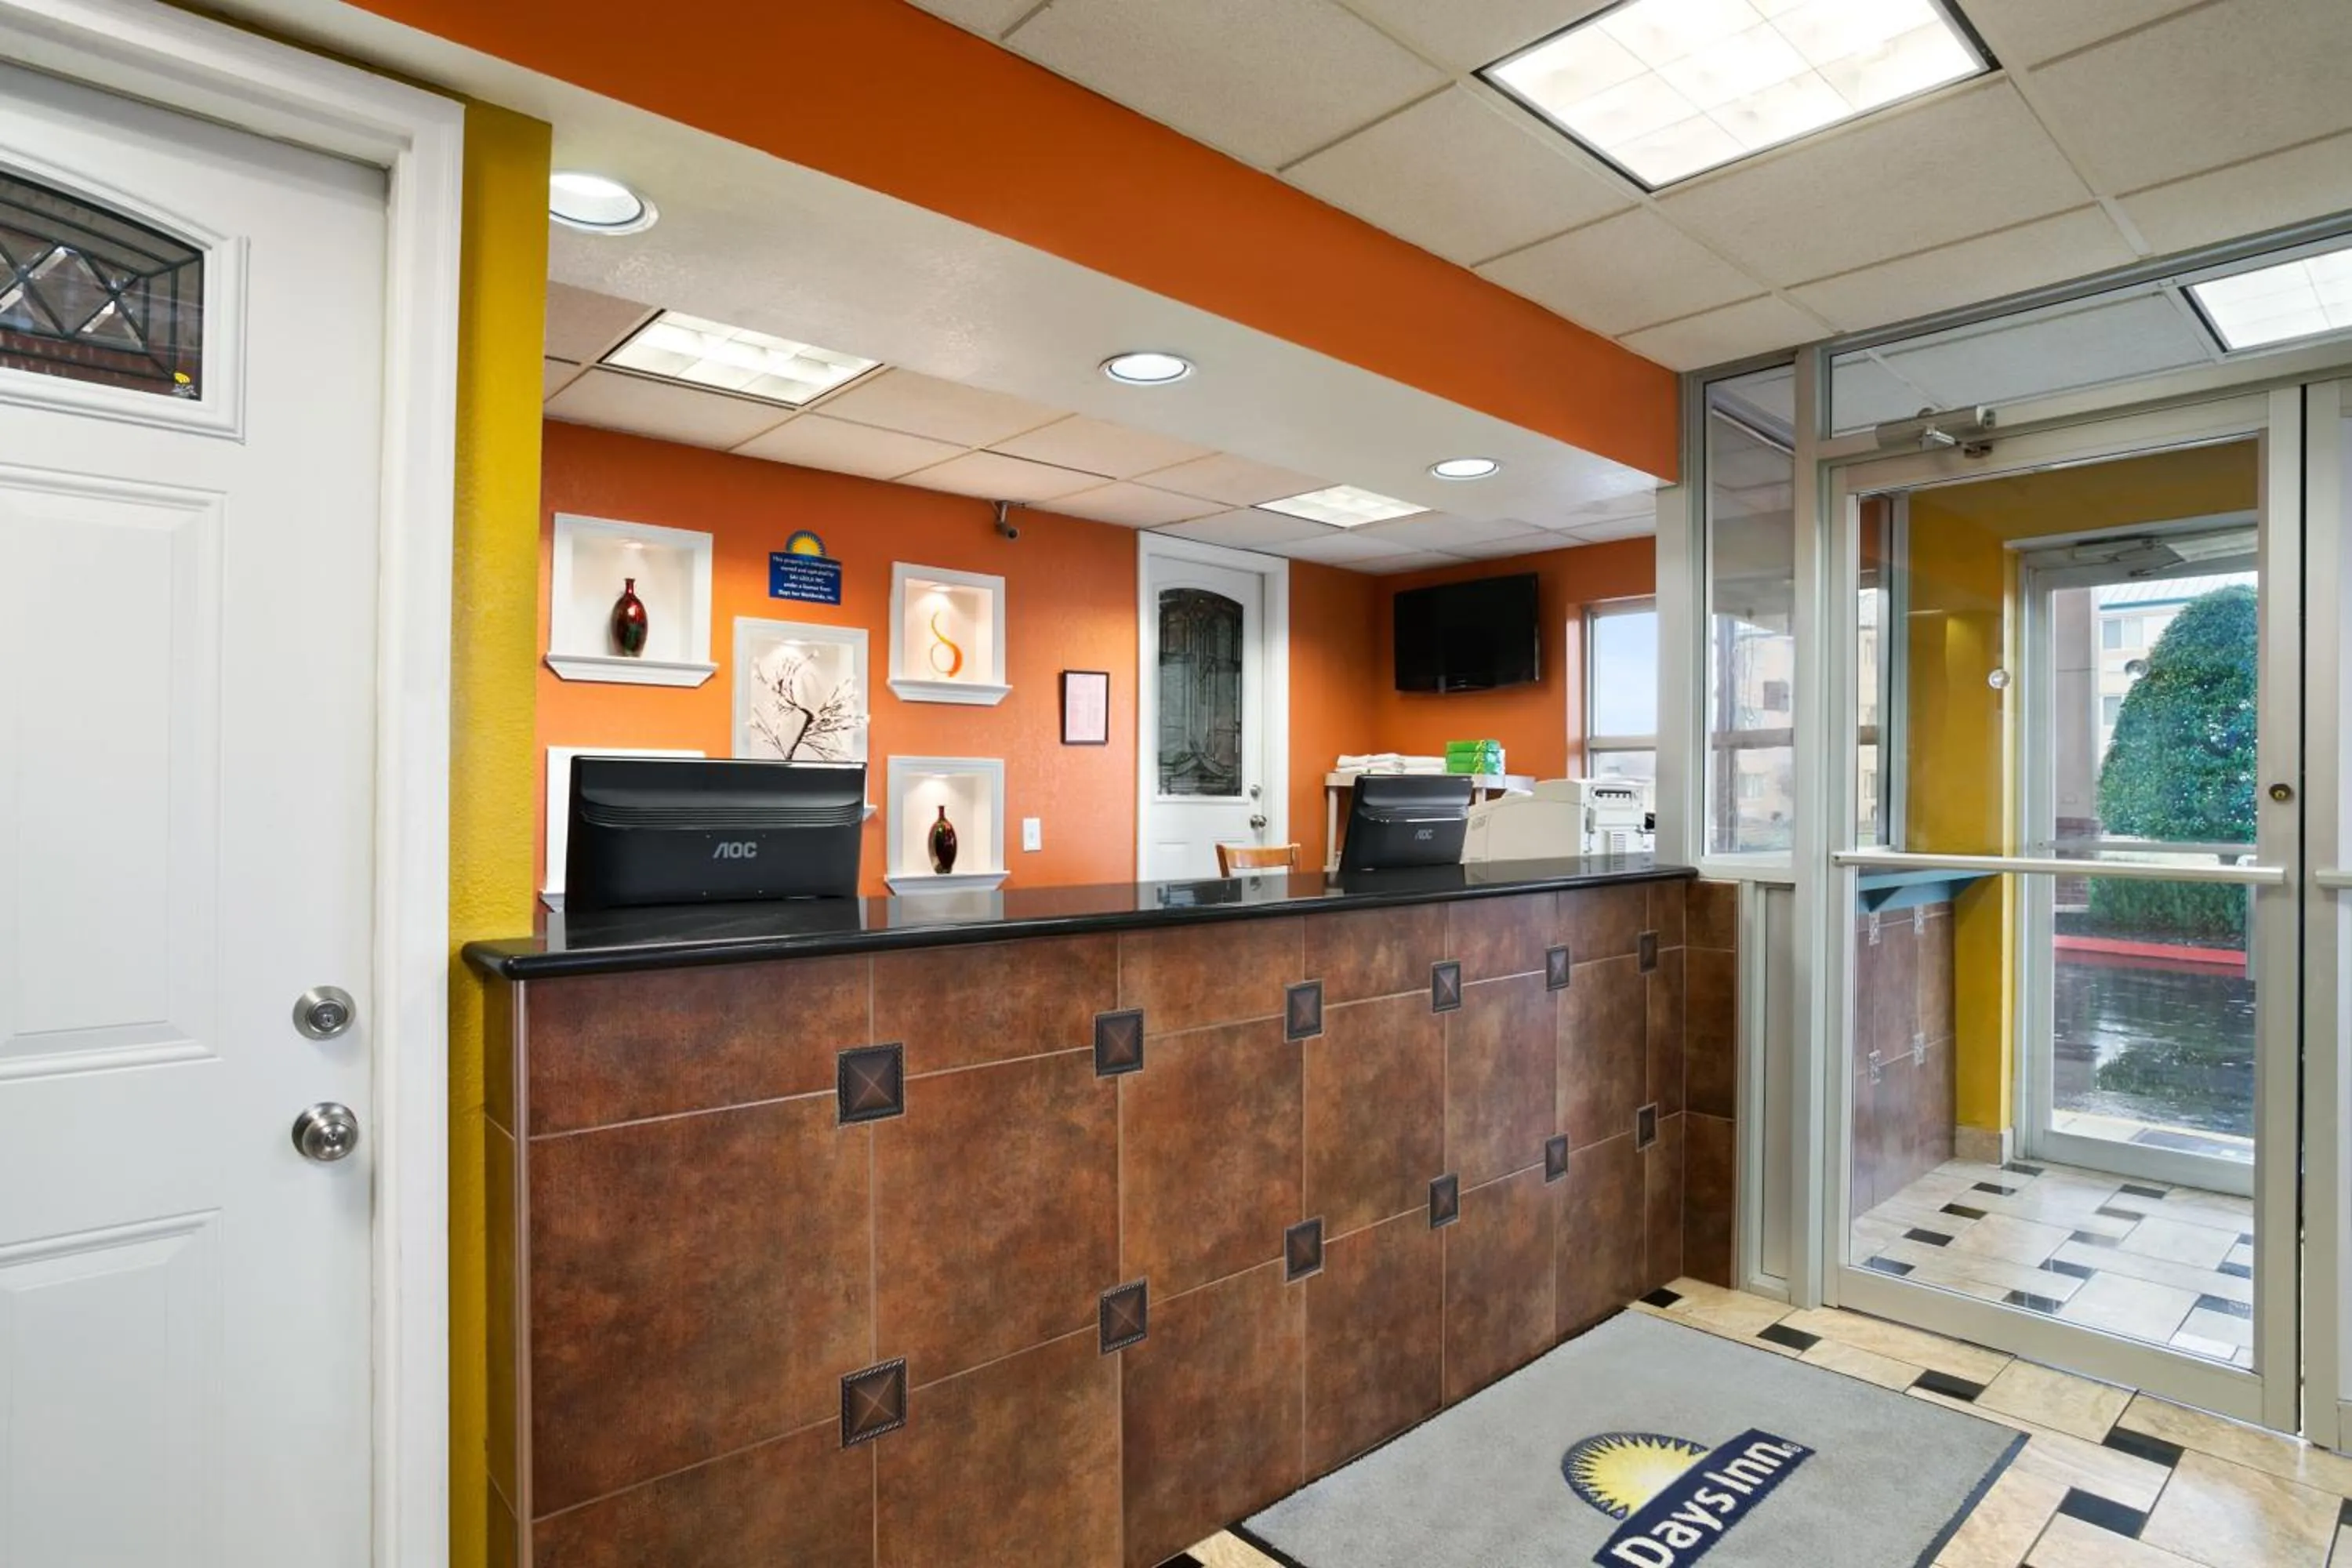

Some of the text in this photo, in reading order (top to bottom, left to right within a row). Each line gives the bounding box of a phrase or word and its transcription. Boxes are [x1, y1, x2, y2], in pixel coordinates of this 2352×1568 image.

[713, 841, 757, 858] AOC
[1610, 1441, 1794, 1568] Days Inn
